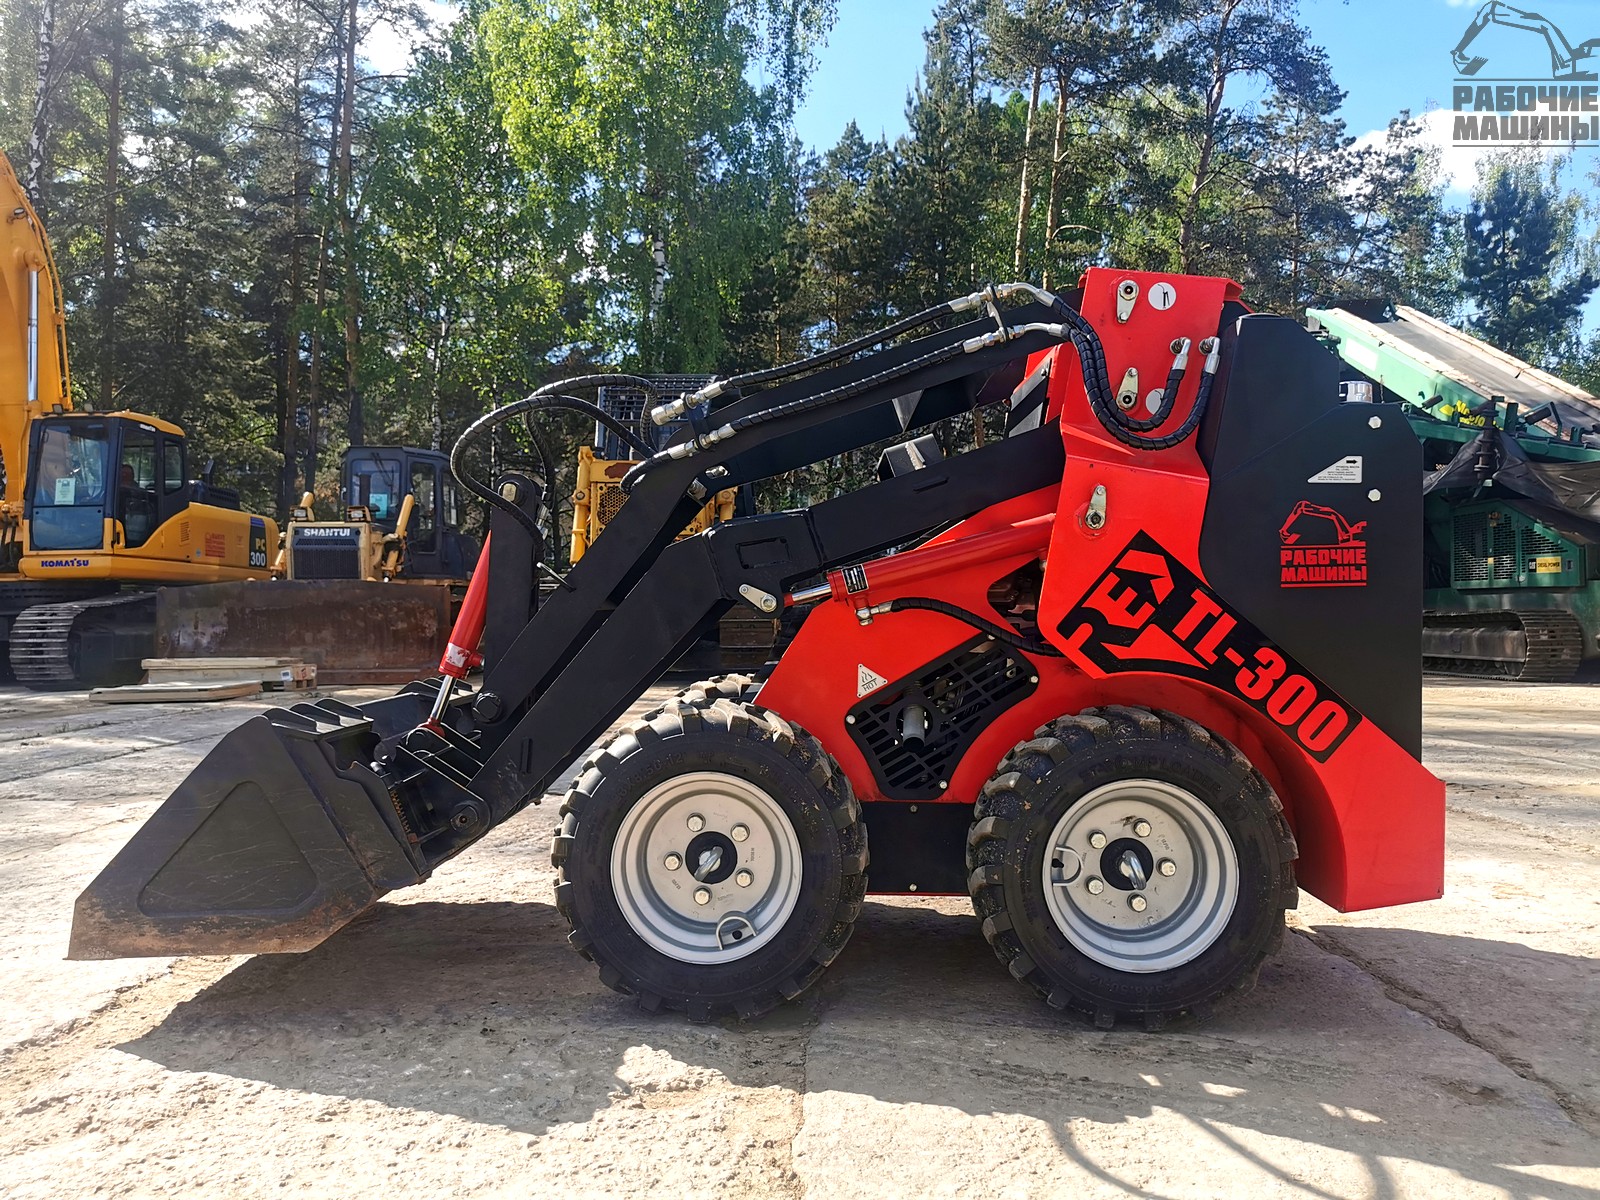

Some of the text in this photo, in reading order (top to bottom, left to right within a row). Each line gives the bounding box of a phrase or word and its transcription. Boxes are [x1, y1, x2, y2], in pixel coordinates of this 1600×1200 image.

[303, 528, 351, 538] SHANTUI
[255, 537, 266, 551] PC
[41, 557, 90, 568] KOMATSU
[250, 552, 266, 567] 300
[1280, 549, 1367, 566] РАБОЧИЕ
[1280, 566, 1367, 582] МАШИНЫ
[1172, 591, 1350, 752] TL-300
[863, 680, 878, 692] HOT
